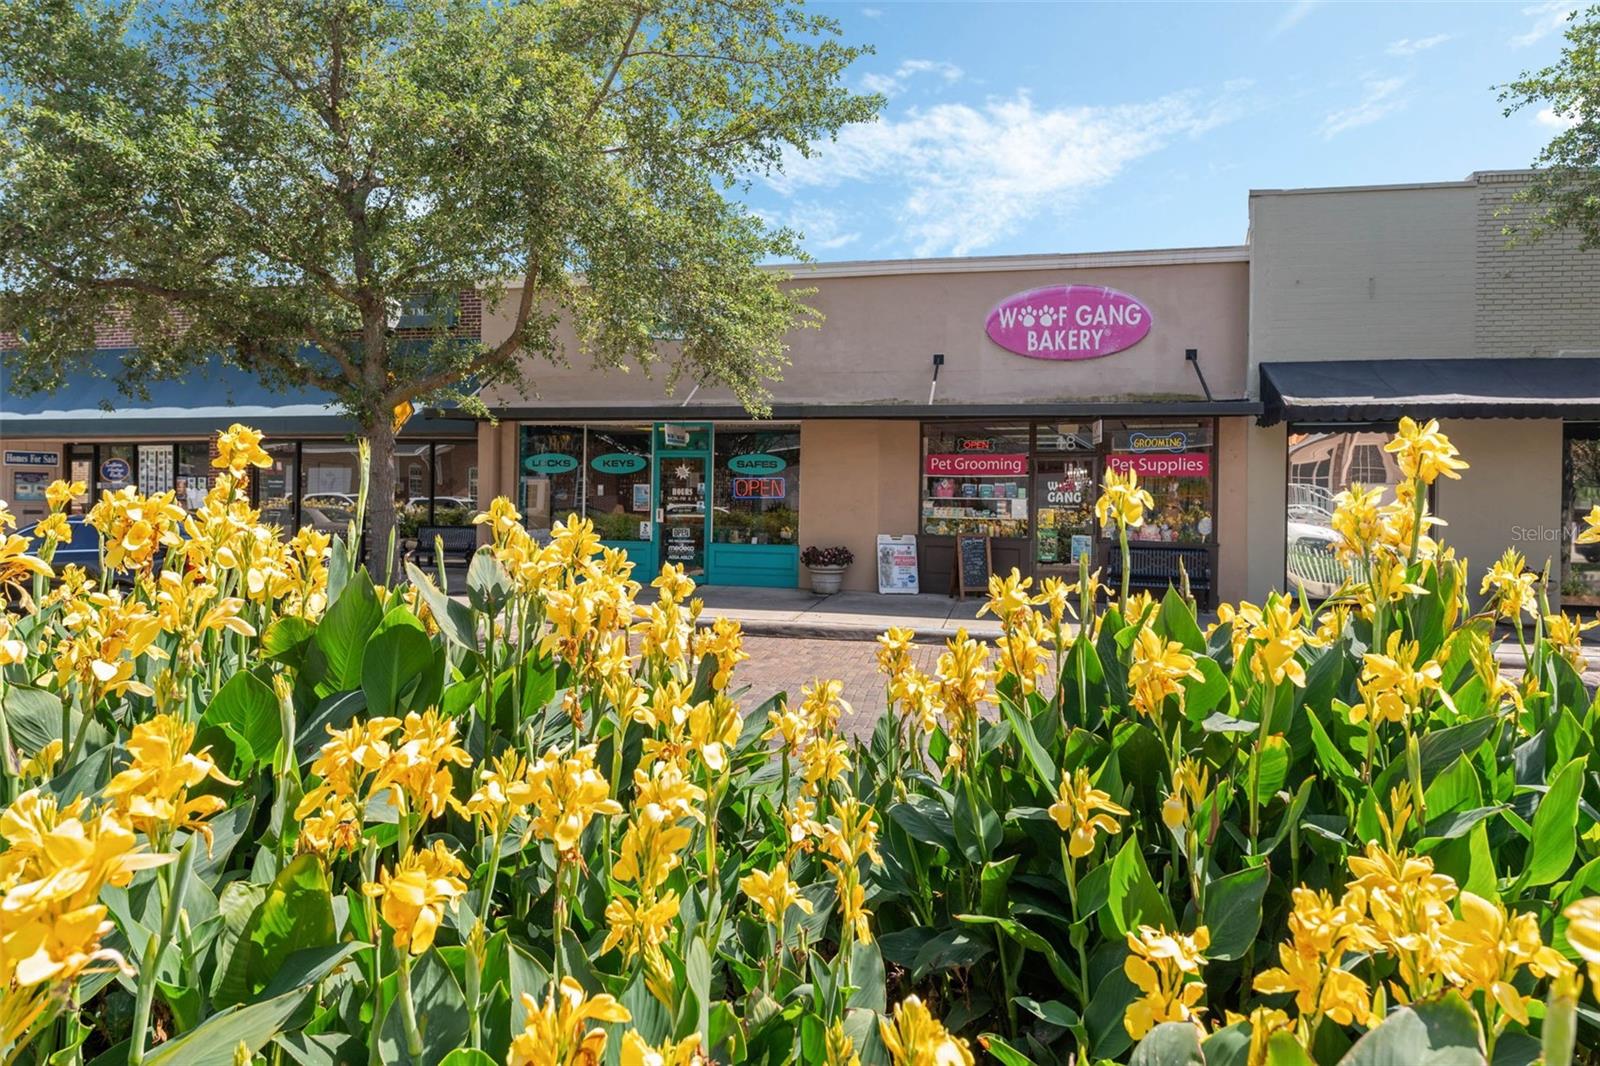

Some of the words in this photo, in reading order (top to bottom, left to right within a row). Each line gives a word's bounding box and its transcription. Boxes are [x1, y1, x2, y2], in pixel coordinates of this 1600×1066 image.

[1075, 304, 1142, 326] GANG
[963, 440, 989, 449] OPEN
[1133, 437, 1182, 448] GROOMING
[6, 453, 28, 463] Homes
[30, 454, 41, 463] For
[43, 454, 57, 464] Sale
[736, 460, 778, 469] SAFES
[931, 458, 952, 470] Pet
[954, 457, 1022, 473] Grooming
[1111, 458, 1135, 471] Pet
[1138, 457, 1204, 474] Supplies
[735, 479, 783, 497] OPEN
[1047, 492, 1082, 503] GANG
